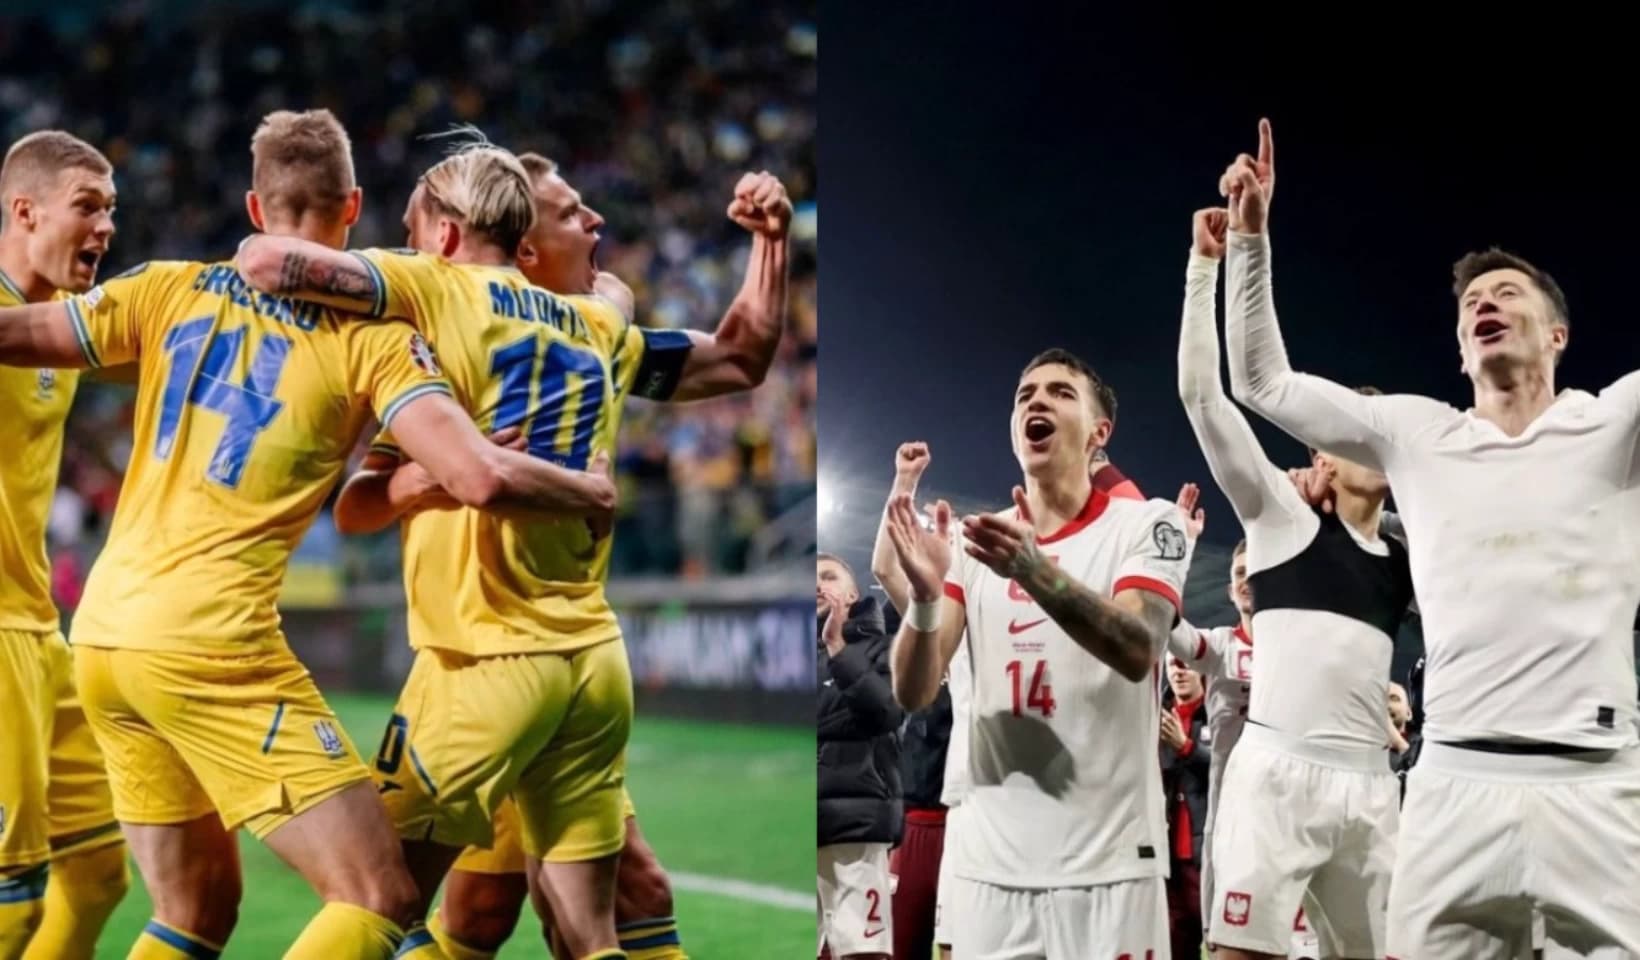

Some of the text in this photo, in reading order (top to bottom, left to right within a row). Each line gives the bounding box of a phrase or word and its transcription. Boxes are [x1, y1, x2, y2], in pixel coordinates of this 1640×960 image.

[154, 313, 294, 490] 14
[490, 333, 605, 471] 10
[1006, 659, 1056, 719] 14
[866, 888, 882, 922] 2
